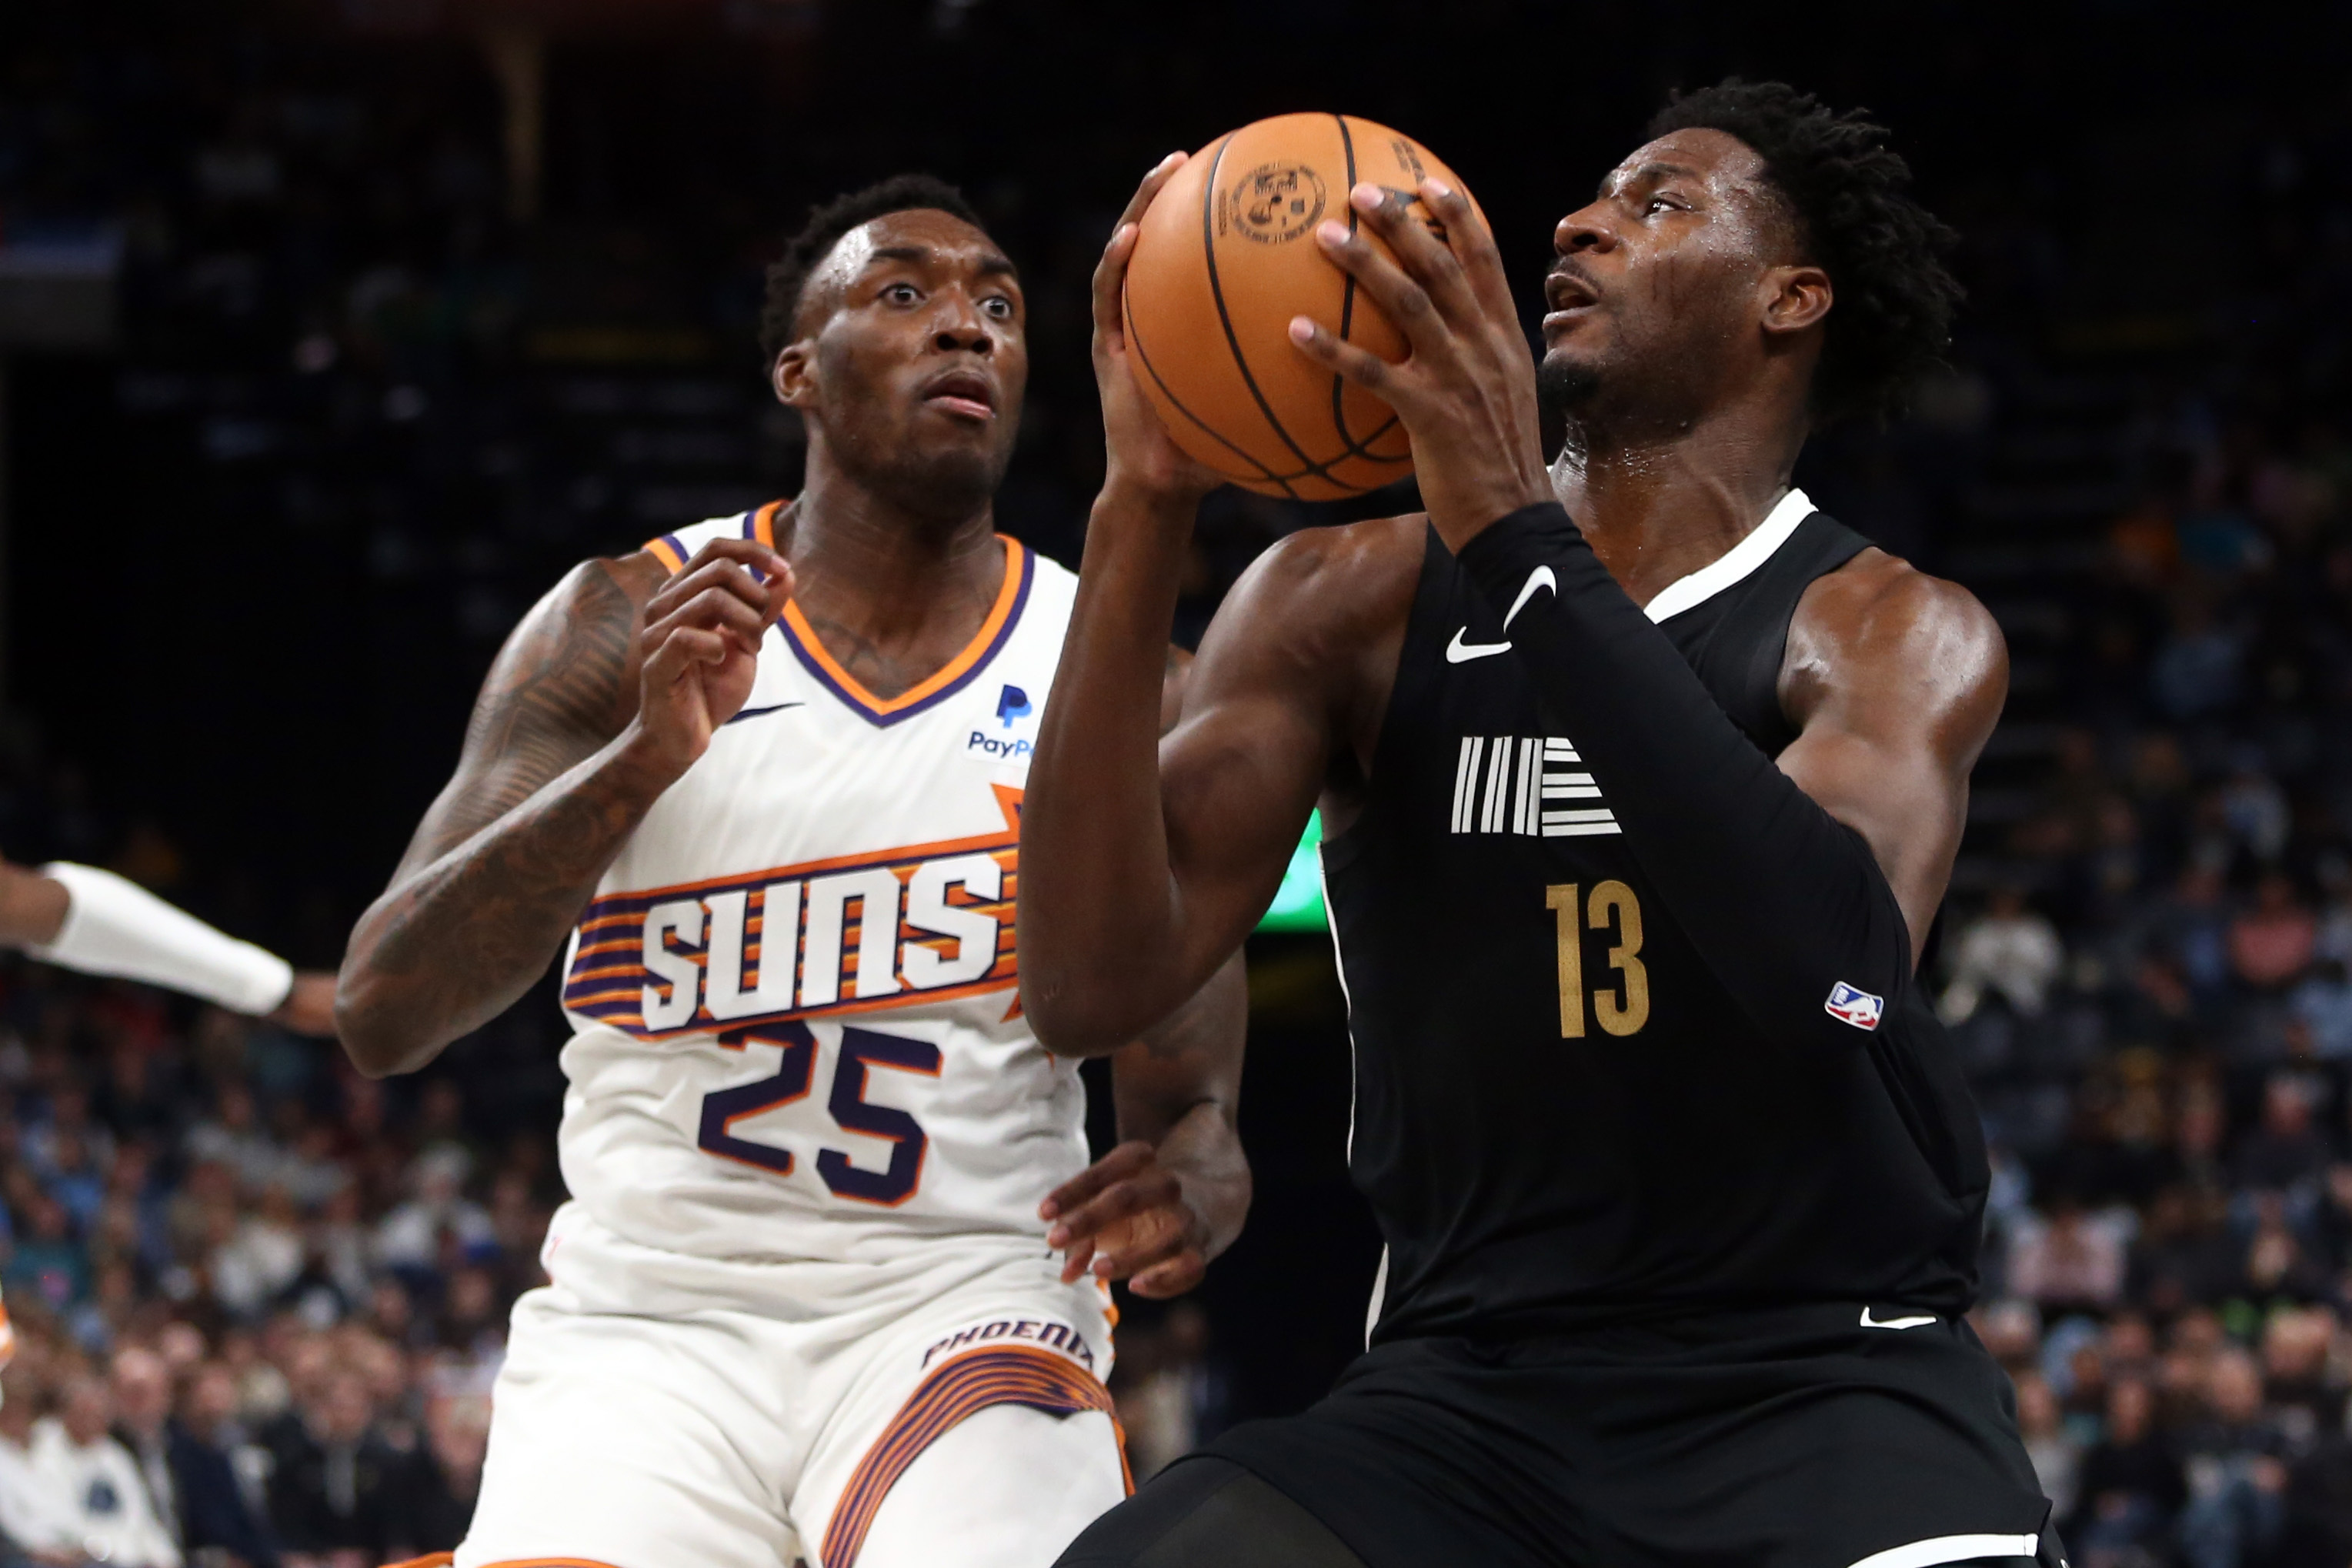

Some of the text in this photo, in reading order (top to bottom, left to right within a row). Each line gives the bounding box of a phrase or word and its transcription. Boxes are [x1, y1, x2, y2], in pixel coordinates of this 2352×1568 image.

[968, 731, 1035, 759] PayP
[641, 854, 1001, 1032] SUNS
[1546, 879, 1650, 1039] 13
[698, 1020, 943, 1207] 25
